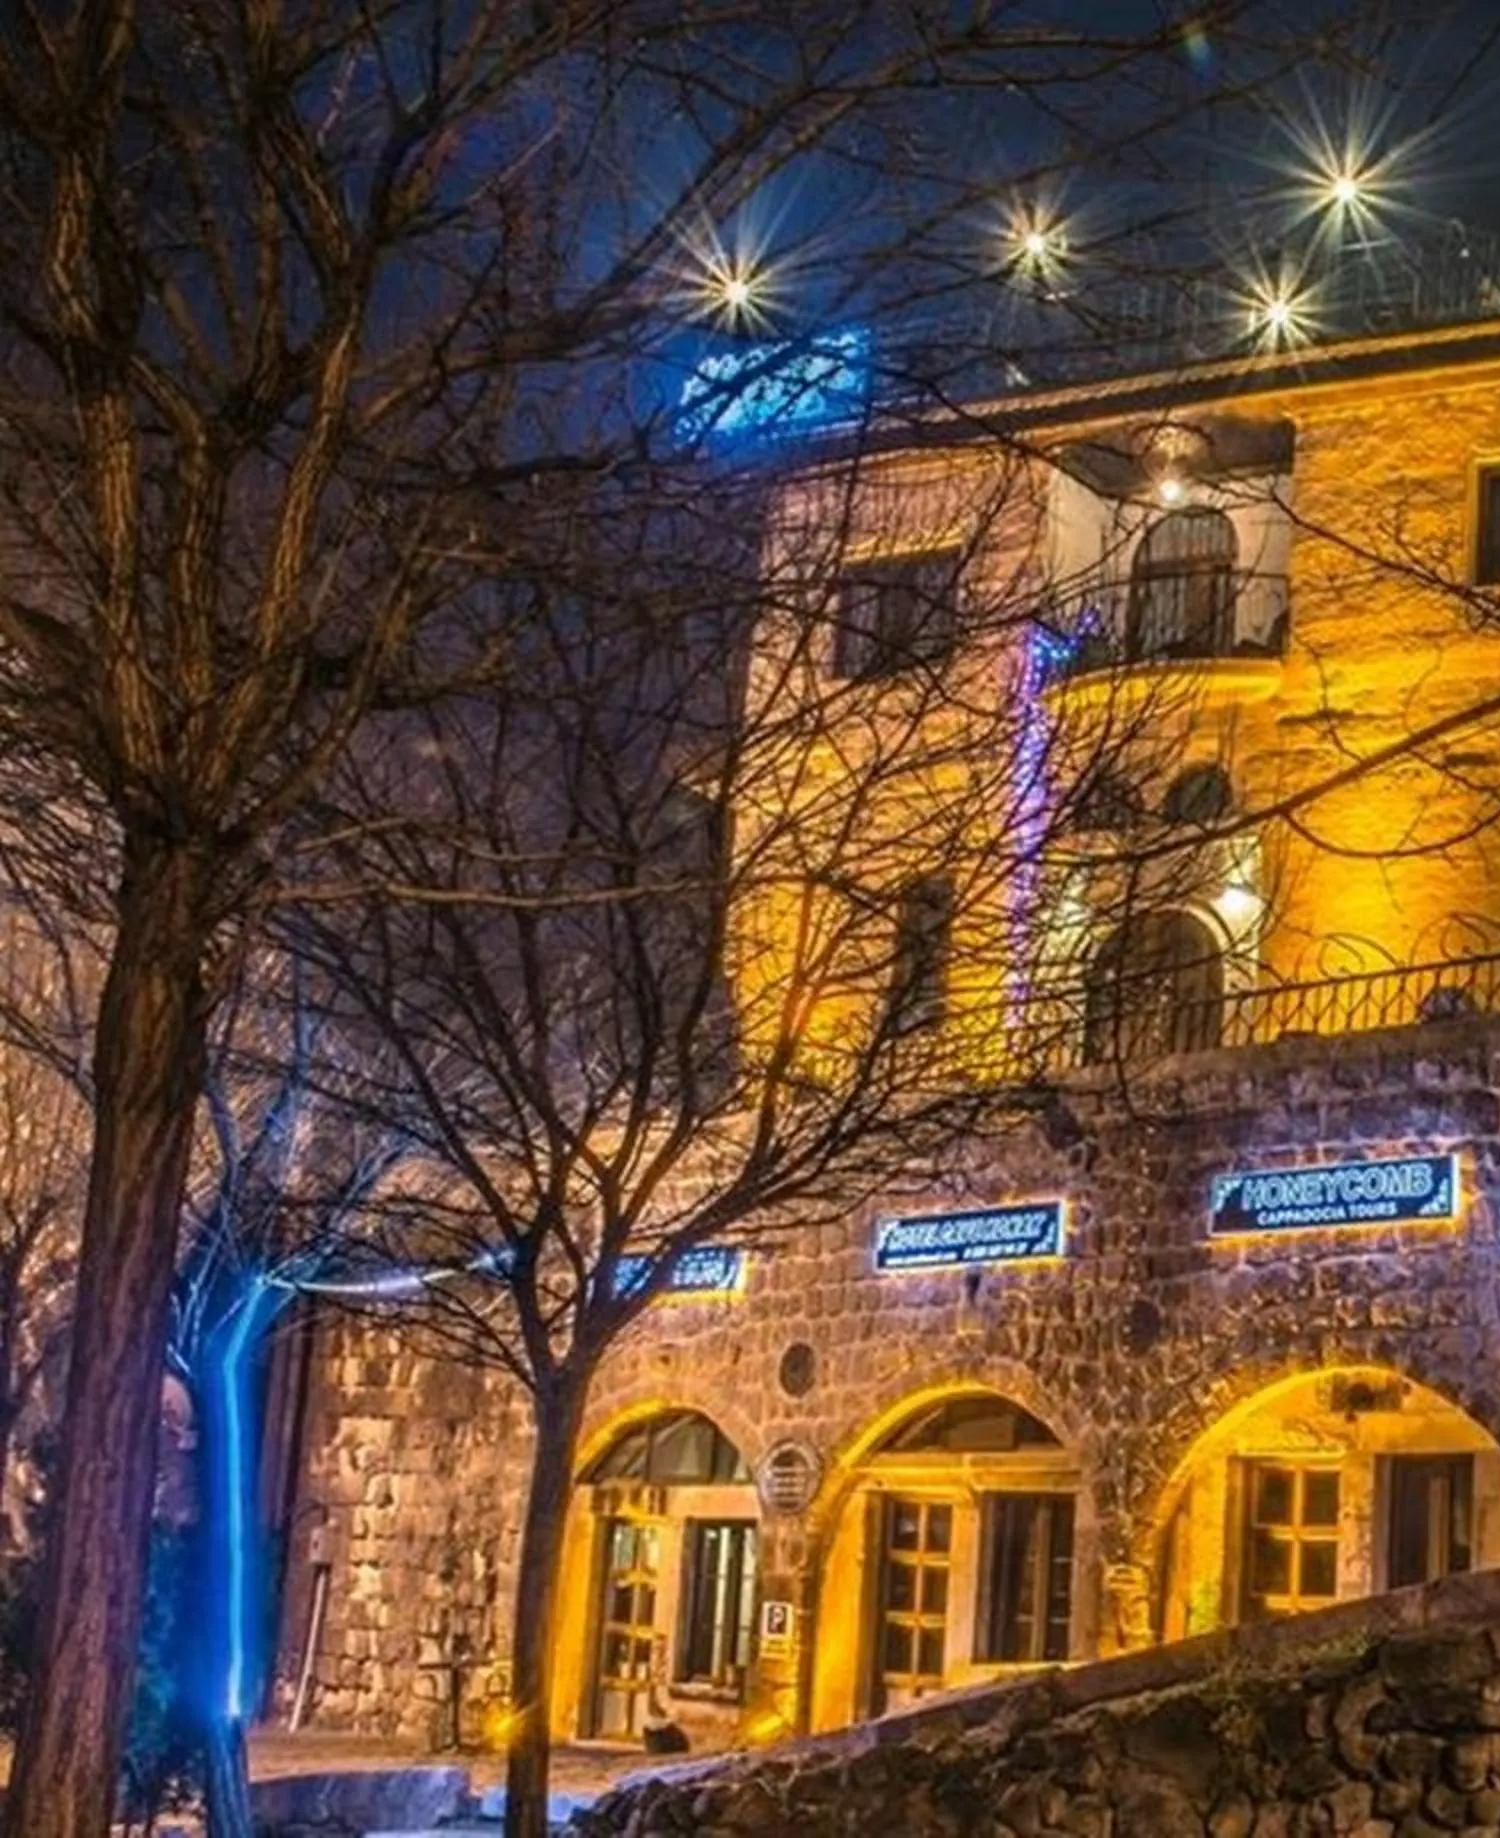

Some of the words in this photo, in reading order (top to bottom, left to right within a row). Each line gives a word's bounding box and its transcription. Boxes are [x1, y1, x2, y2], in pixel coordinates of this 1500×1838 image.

[1241, 1163, 1433, 1211] HONEYCOMB
[1257, 1205, 1346, 1226] CAPPADOCIA
[1349, 1201, 1398, 1219] TOURS
